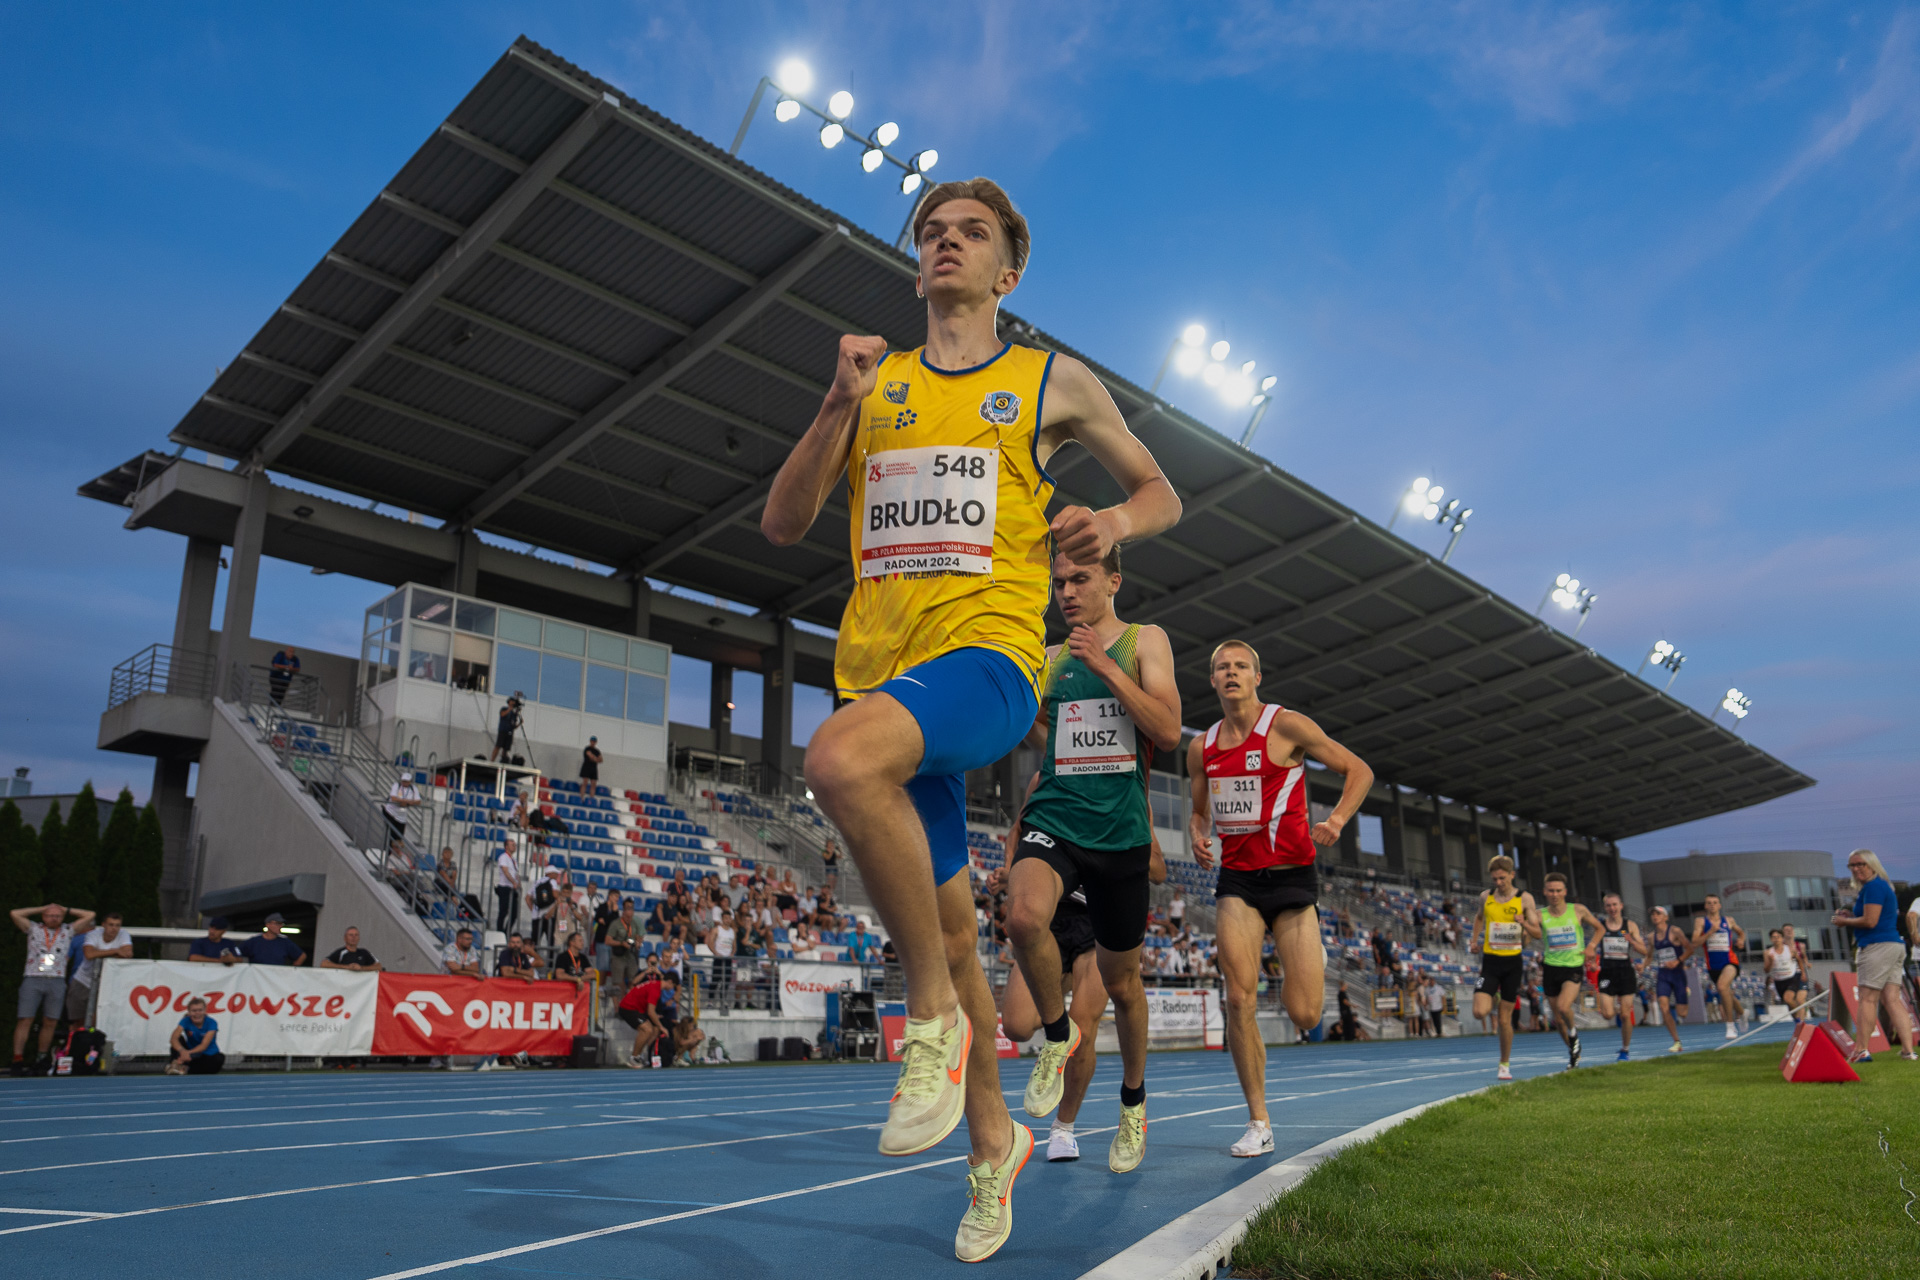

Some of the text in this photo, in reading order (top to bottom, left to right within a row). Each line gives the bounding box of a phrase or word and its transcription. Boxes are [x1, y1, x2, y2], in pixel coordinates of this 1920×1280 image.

[932, 454, 986, 479] 548
[870, 498, 986, 532] BRUDŁO
[895, 544, 941, 554] Mistrzostwa
[941, 543, 965, 552] Polski
[965, 545, 981, 554] U20
[884, 556, 961, 571] RADOM 2024
[1072, 729, 1118, 748] KUSZ
[1072, 765, 1101, 773] RADOM
[1233, 780, 1256, 792] 311
[1215, 800, 1253, 814] KILIAN
[1029, 832, 1053, 845] 14
[463, 999, 574, 1031] ORLEN
[279, 1021, 343, 1033] serce Polski
